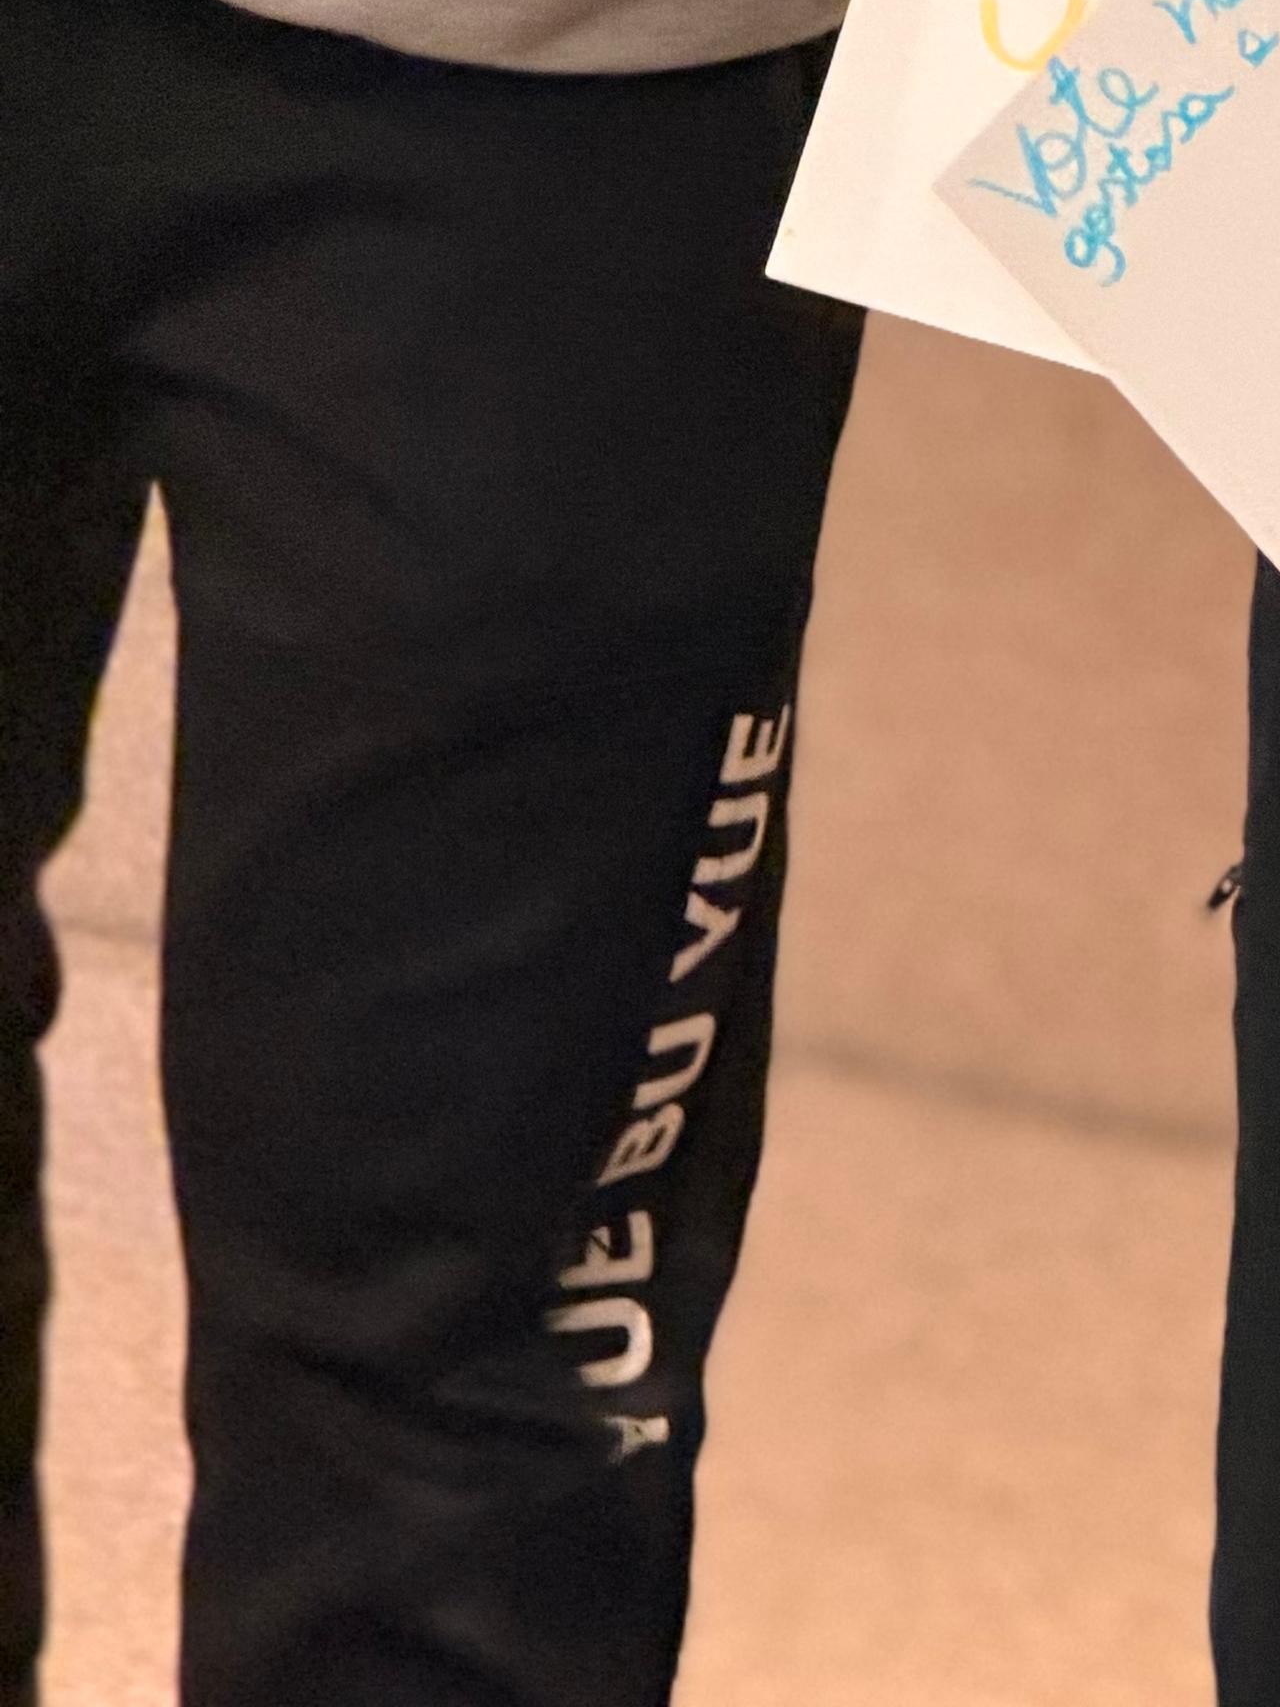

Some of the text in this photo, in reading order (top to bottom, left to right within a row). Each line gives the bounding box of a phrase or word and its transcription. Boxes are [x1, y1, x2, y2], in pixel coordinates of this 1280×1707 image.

[1064, 85, 1235, 285] gostosa
[596, 1011, 718, 1189] BU
[668, 701, 793, 984] YUE
